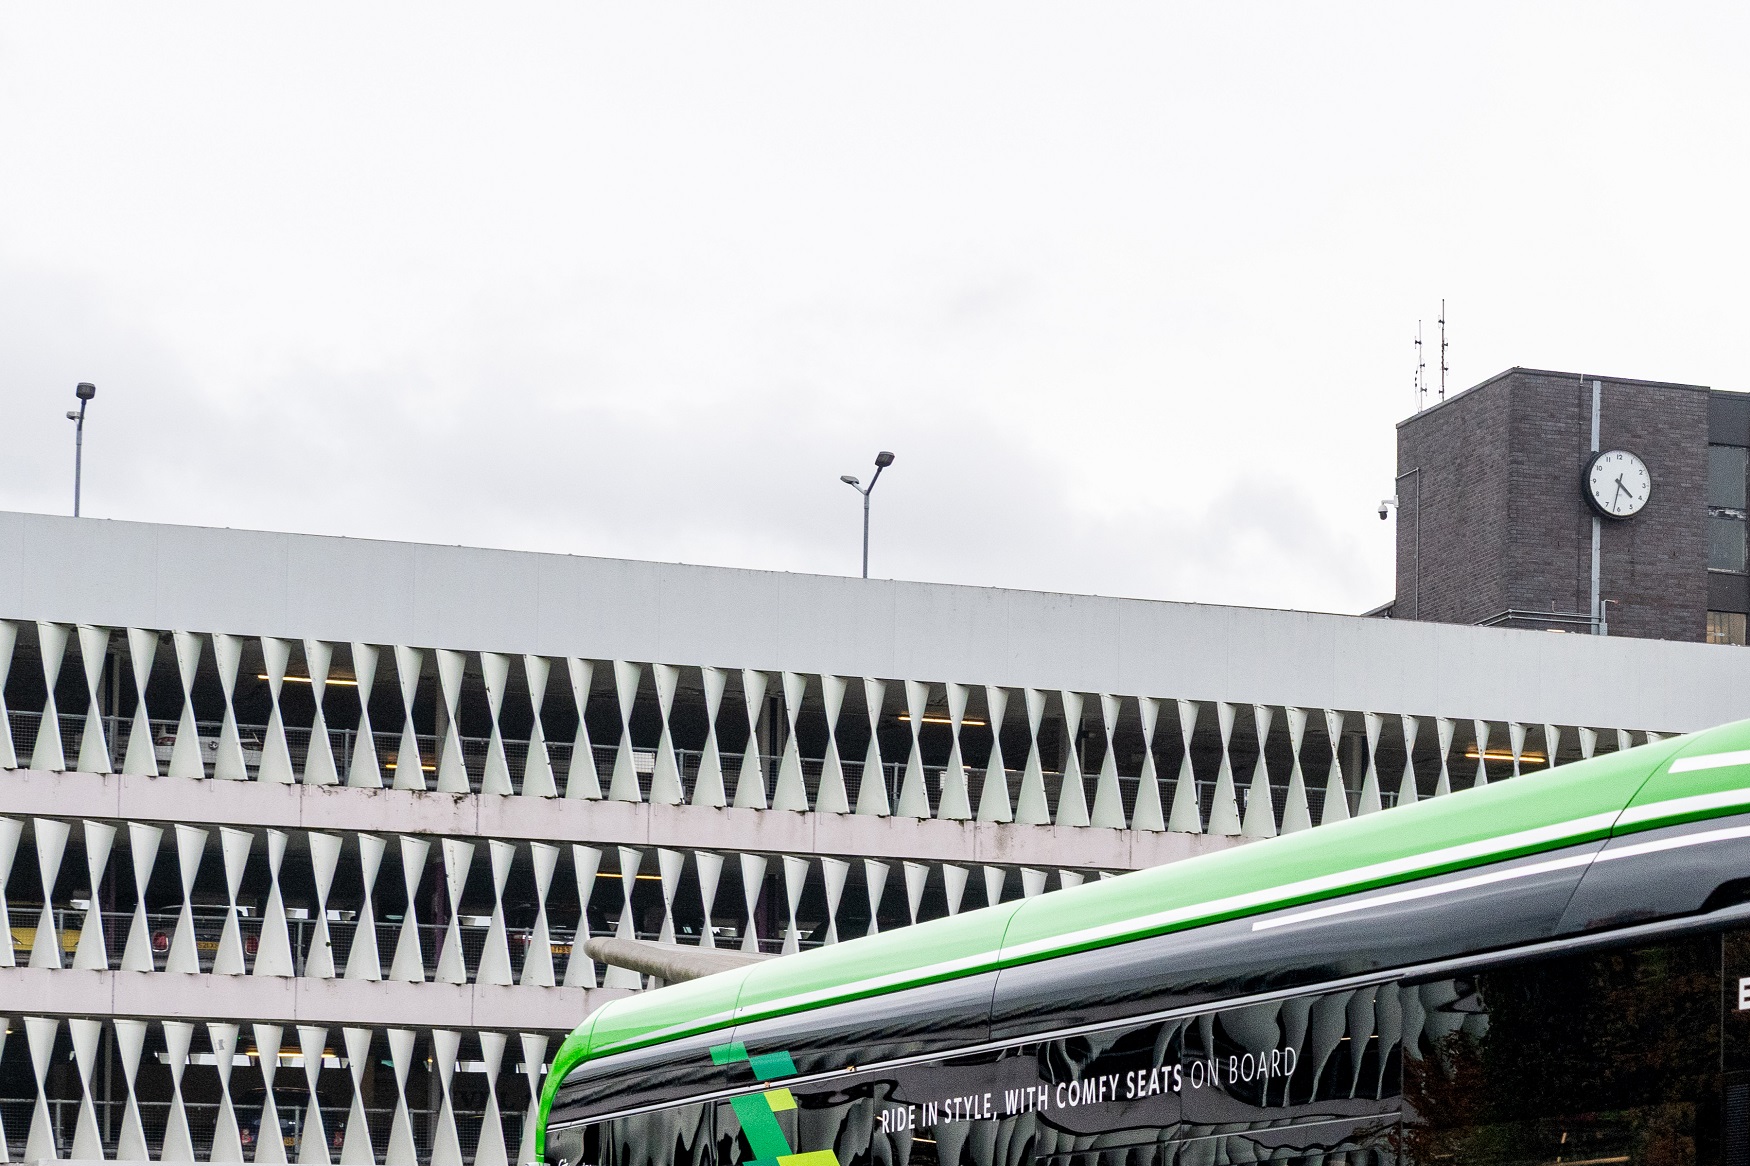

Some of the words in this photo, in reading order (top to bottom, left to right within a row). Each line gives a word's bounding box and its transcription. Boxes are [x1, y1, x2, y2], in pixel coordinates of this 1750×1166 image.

[882, 1104, 916, 1134] RIDE
[922, 1101, 938, 1127] IN
[944, 1093, 997, 1122] STYLE,
[1005, 1084, 1048, 1115] WITH
[1056, 1074, 1119, 1109] COMFY
[1126, 1064, 1182, 1099] SEATS
[1191, 1058, 1219, 1088] ON
[1230, 1047, 1296, 1084] BOARD
